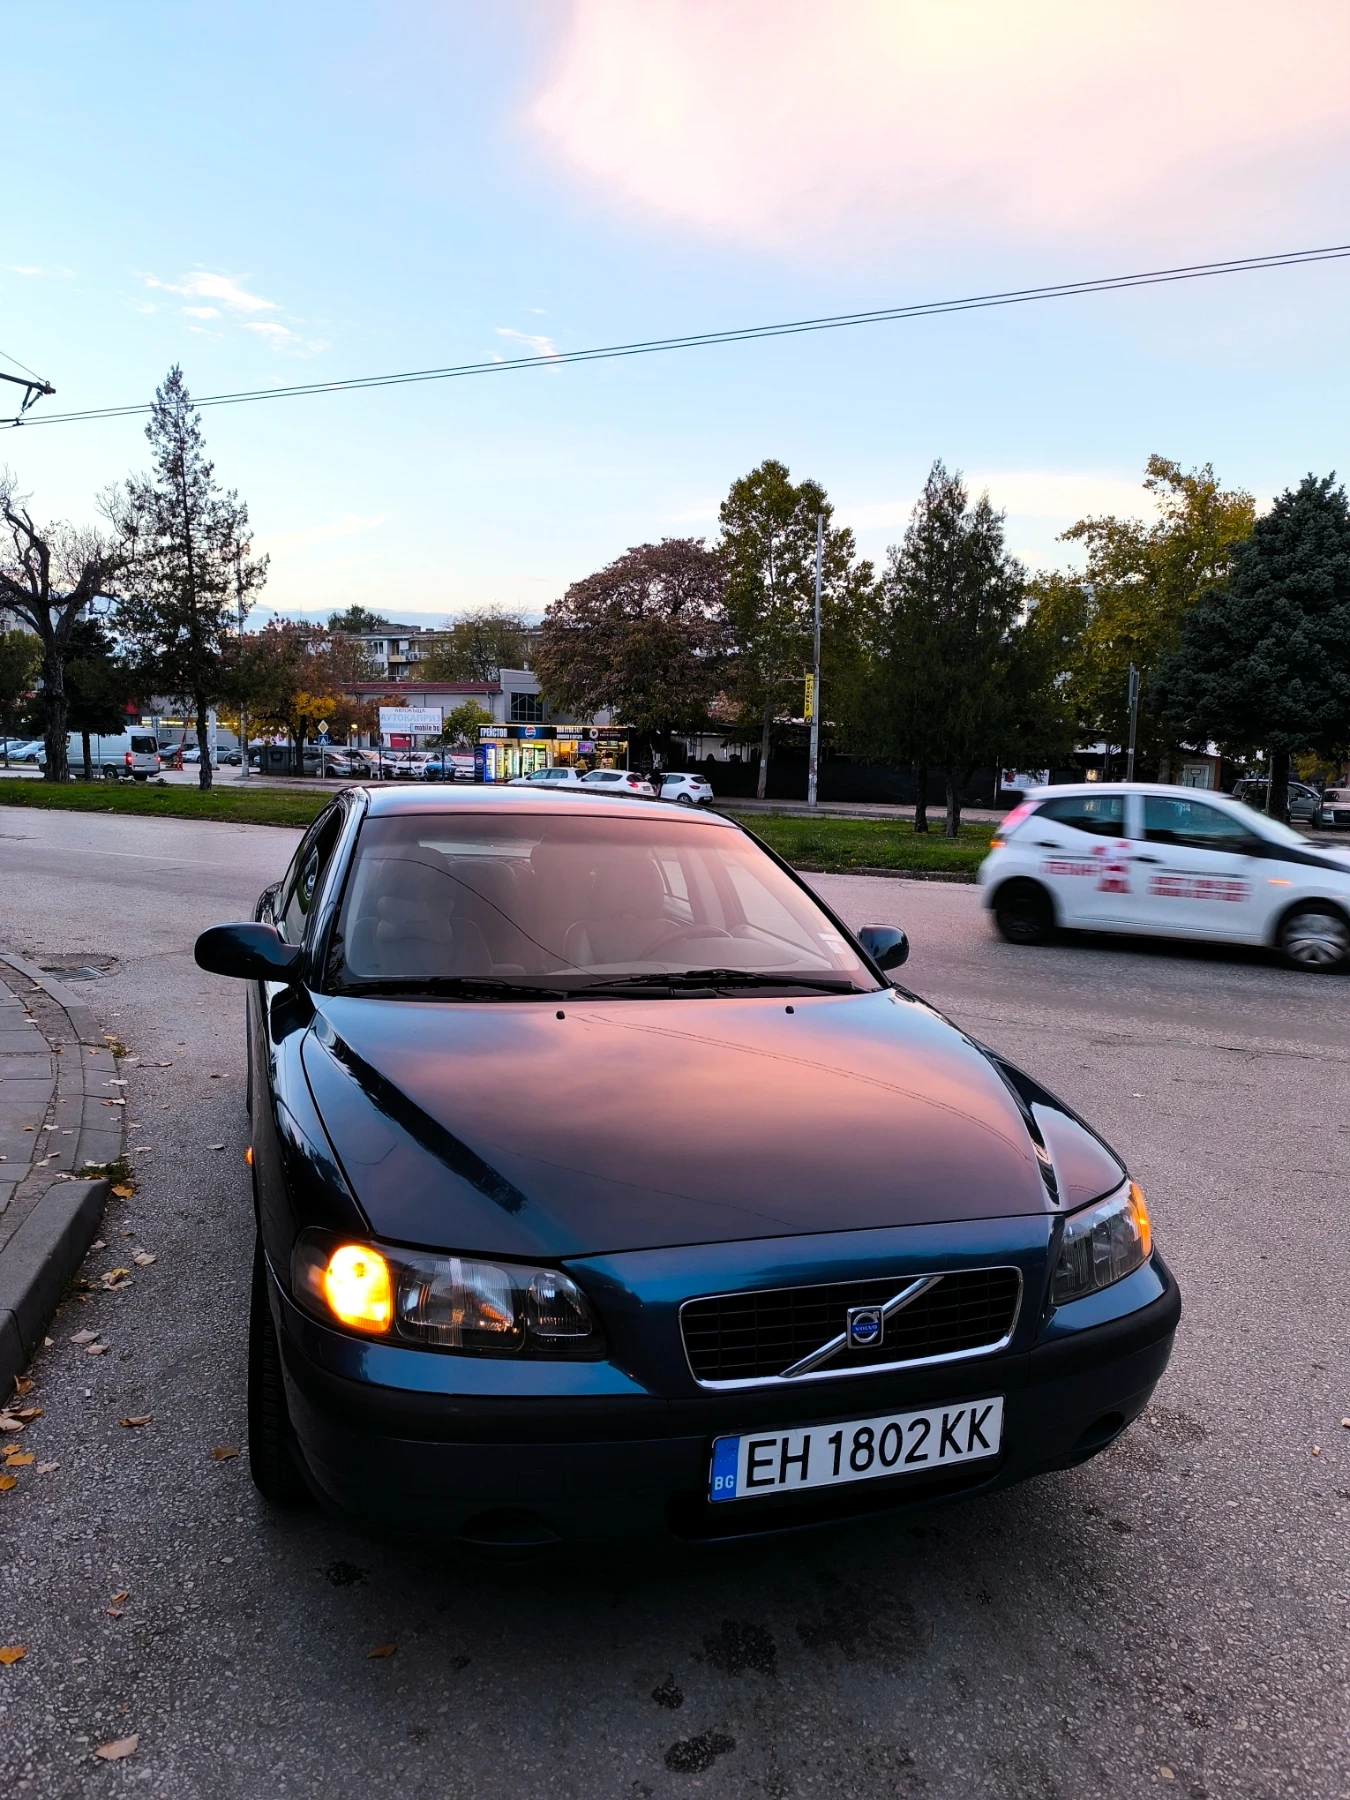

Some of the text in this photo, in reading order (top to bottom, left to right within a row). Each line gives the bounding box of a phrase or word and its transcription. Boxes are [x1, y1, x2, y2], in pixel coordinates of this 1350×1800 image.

[381, 713, 441, 722] АУТОКАПРИЗ
[855, 1324, 878, 1332] VOLVO
[714, 1475, 734, 1491] BG
